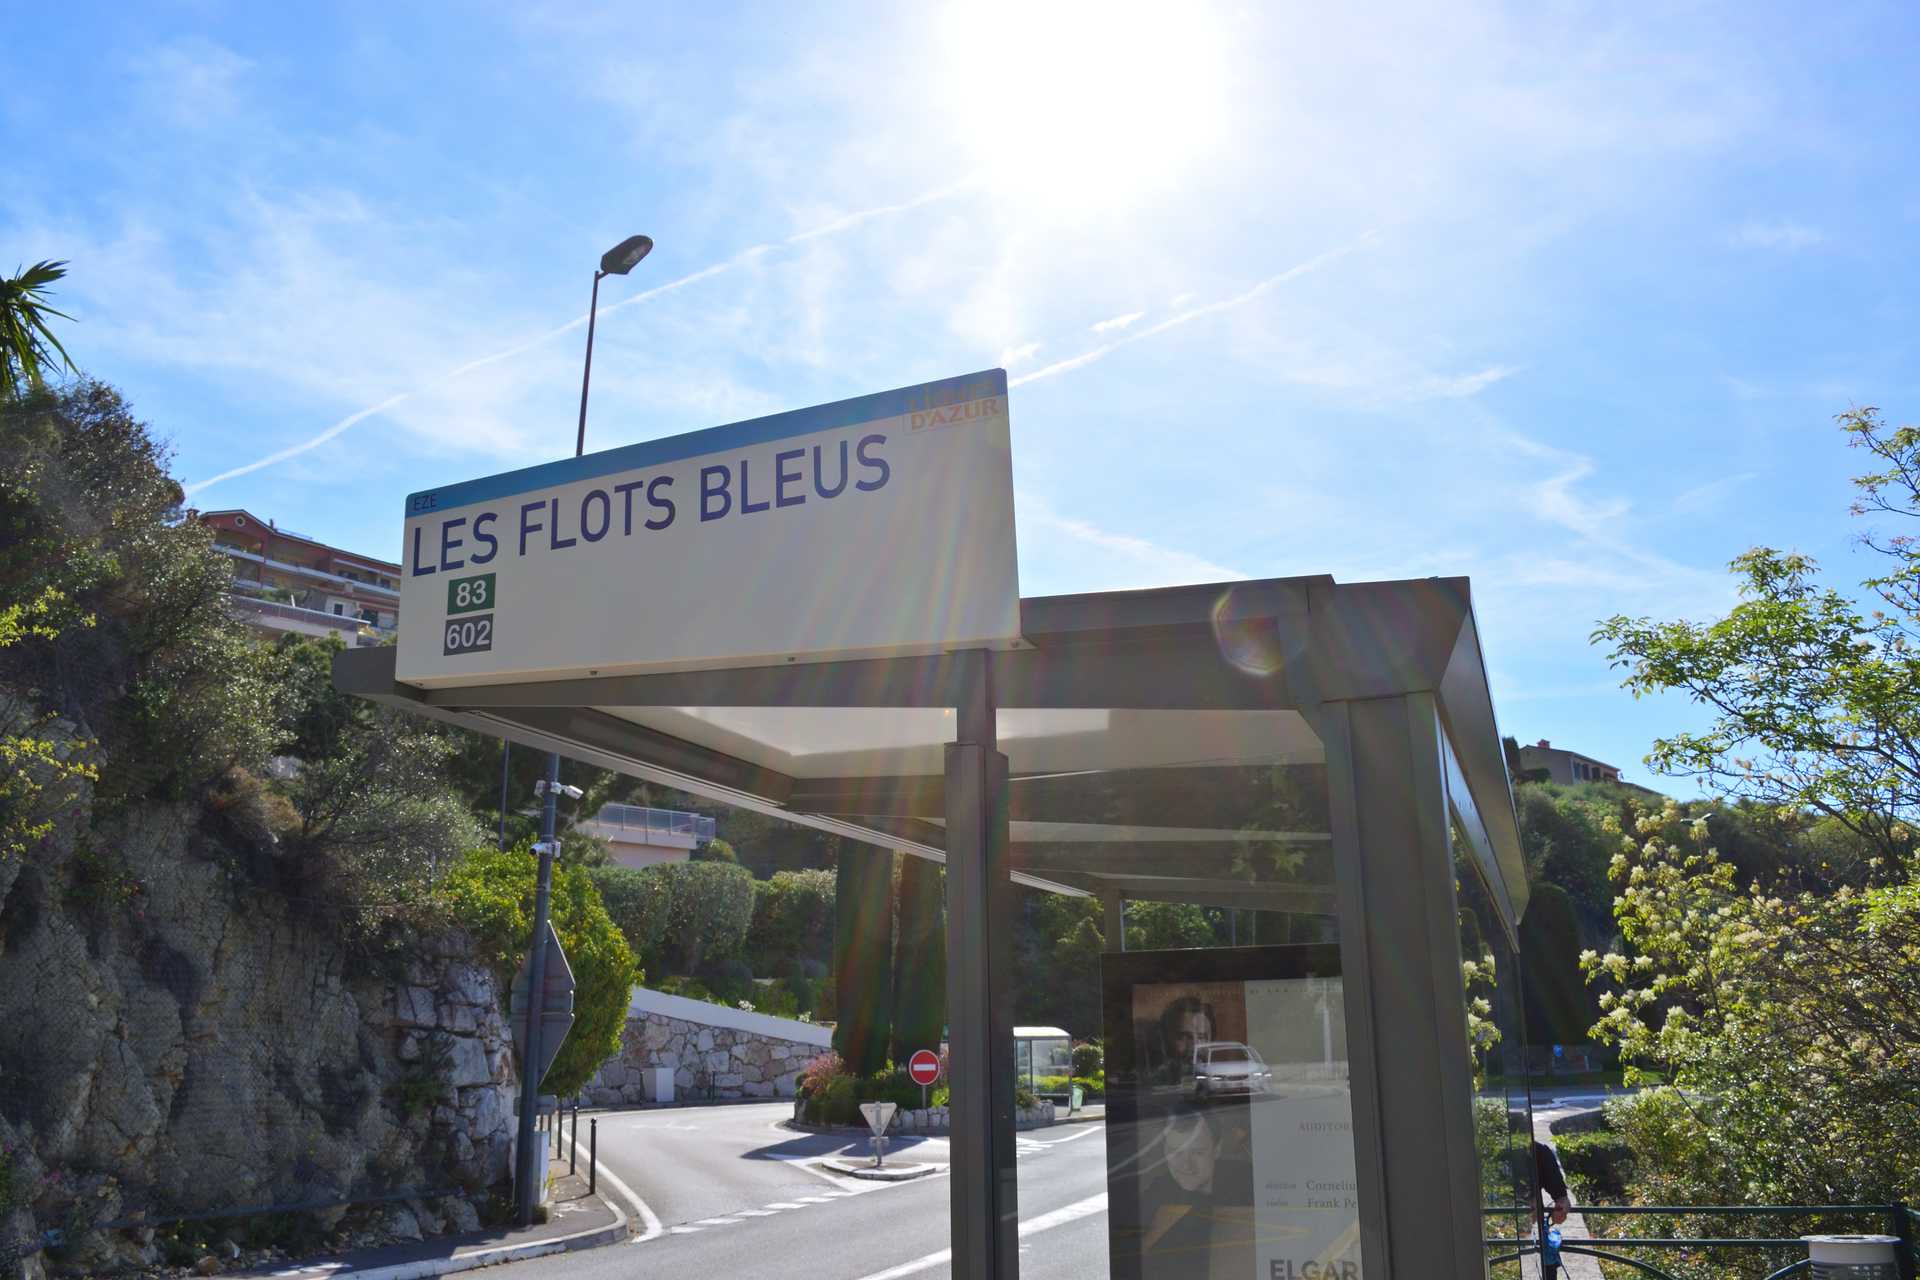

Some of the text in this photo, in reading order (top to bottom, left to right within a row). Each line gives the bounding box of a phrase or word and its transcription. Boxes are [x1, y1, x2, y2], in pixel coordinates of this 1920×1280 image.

[412, 433, 891, 577] LES FLOTS BLEUS
[414, 494, 437, 511] EZE
[456, 579, 487, 608] 83
[446, 620, 491, 650] 602
[1307, 1197, 1341, 1209] Frank
[1269, 1259, 1358, 1280] ELGAR
